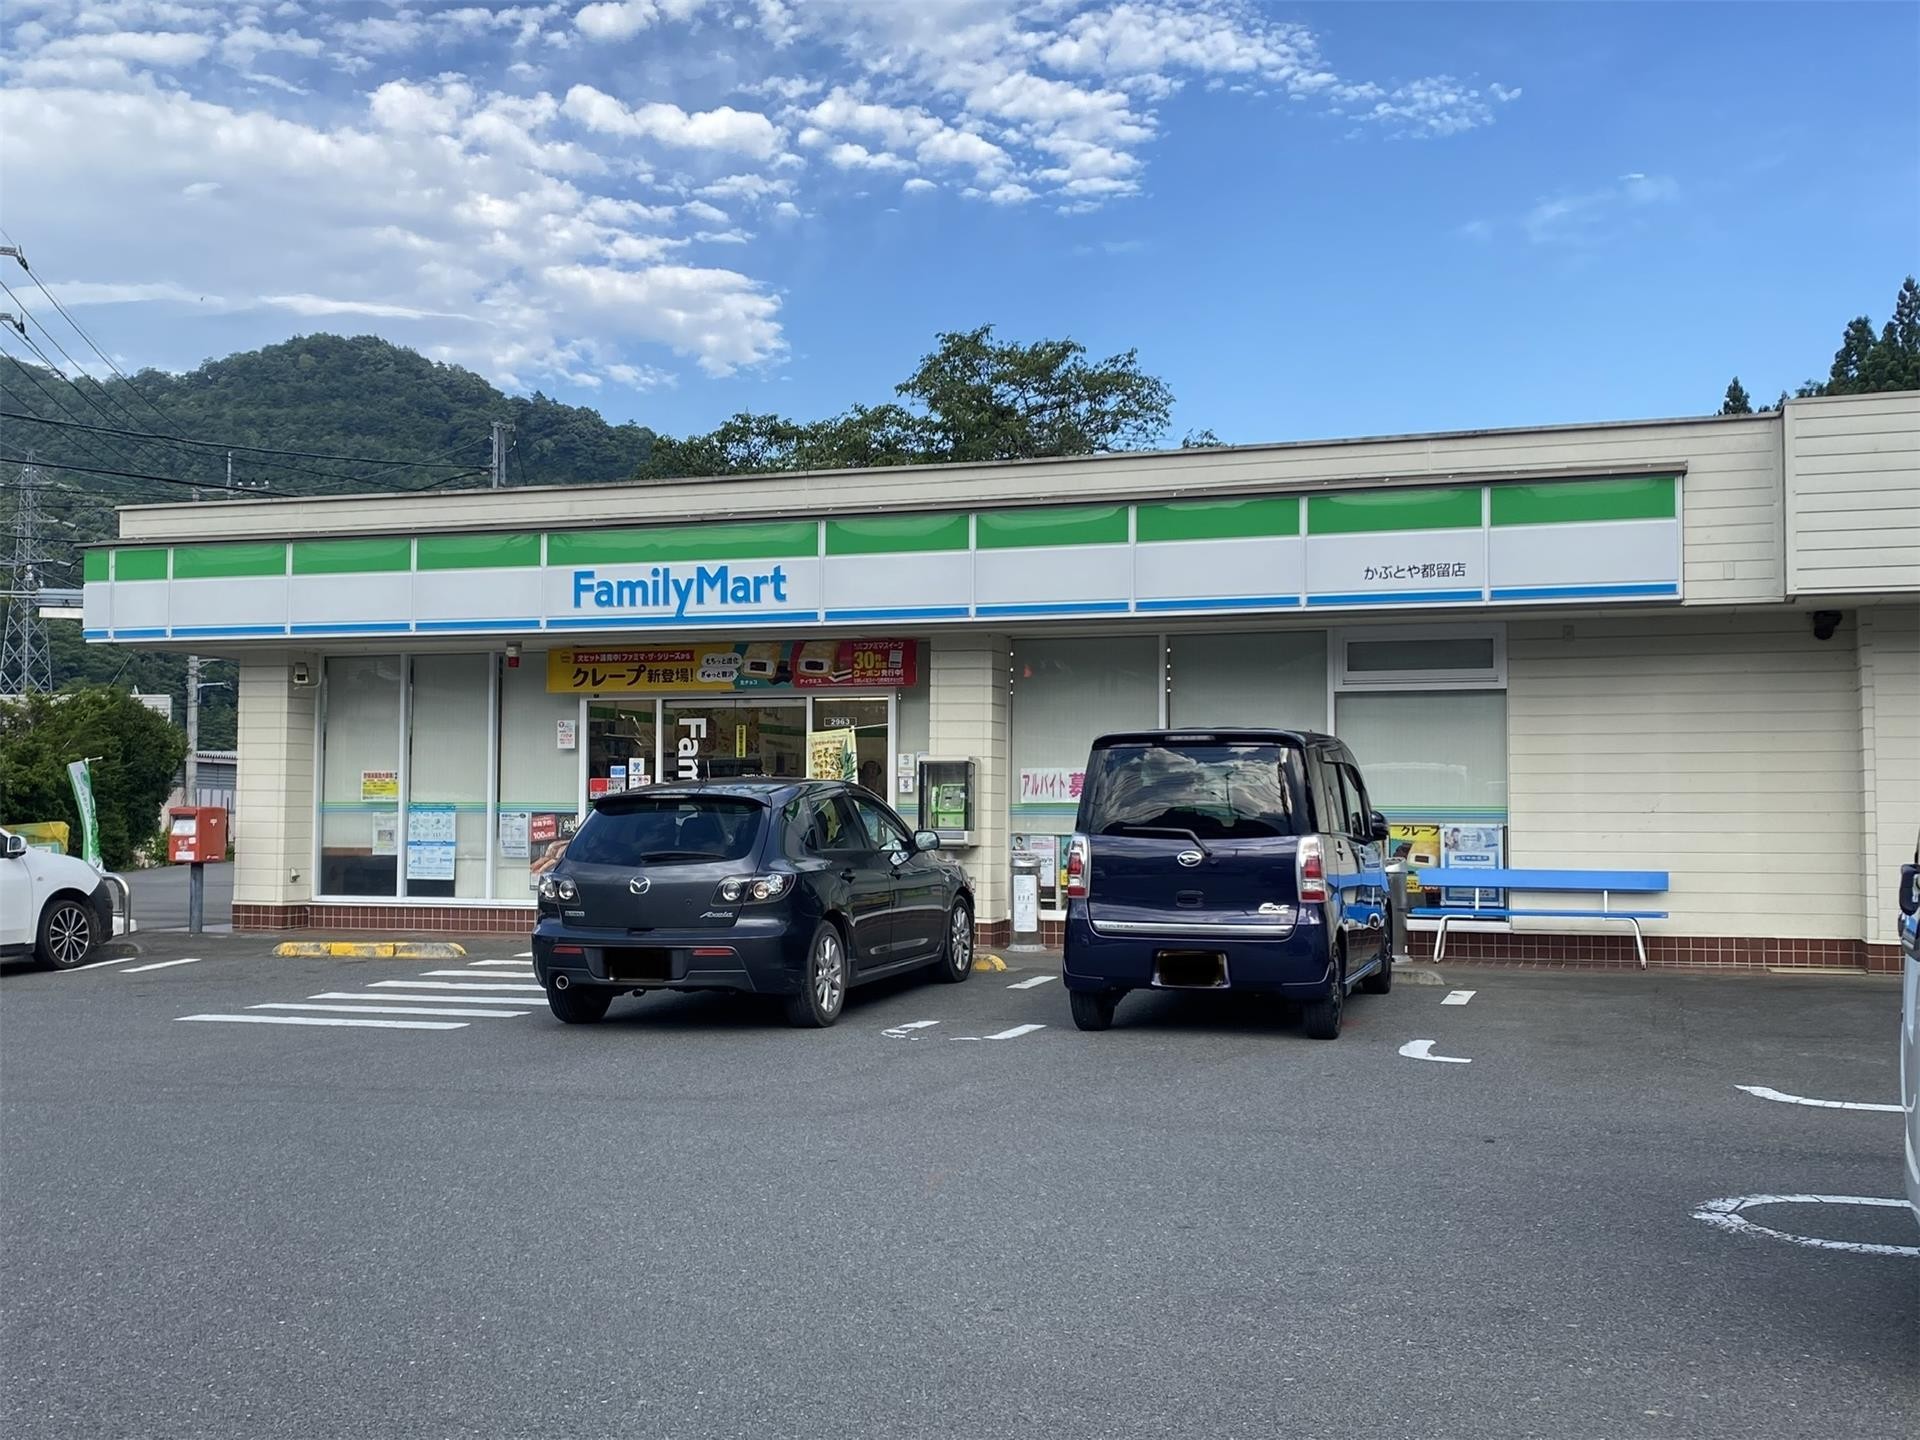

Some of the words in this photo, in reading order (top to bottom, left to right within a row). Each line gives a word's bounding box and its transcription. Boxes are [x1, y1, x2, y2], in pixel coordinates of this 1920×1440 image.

[1363, 562, 1466, 580] かぶとや都留店
[573, 564, 787, 618] FamilyMart
